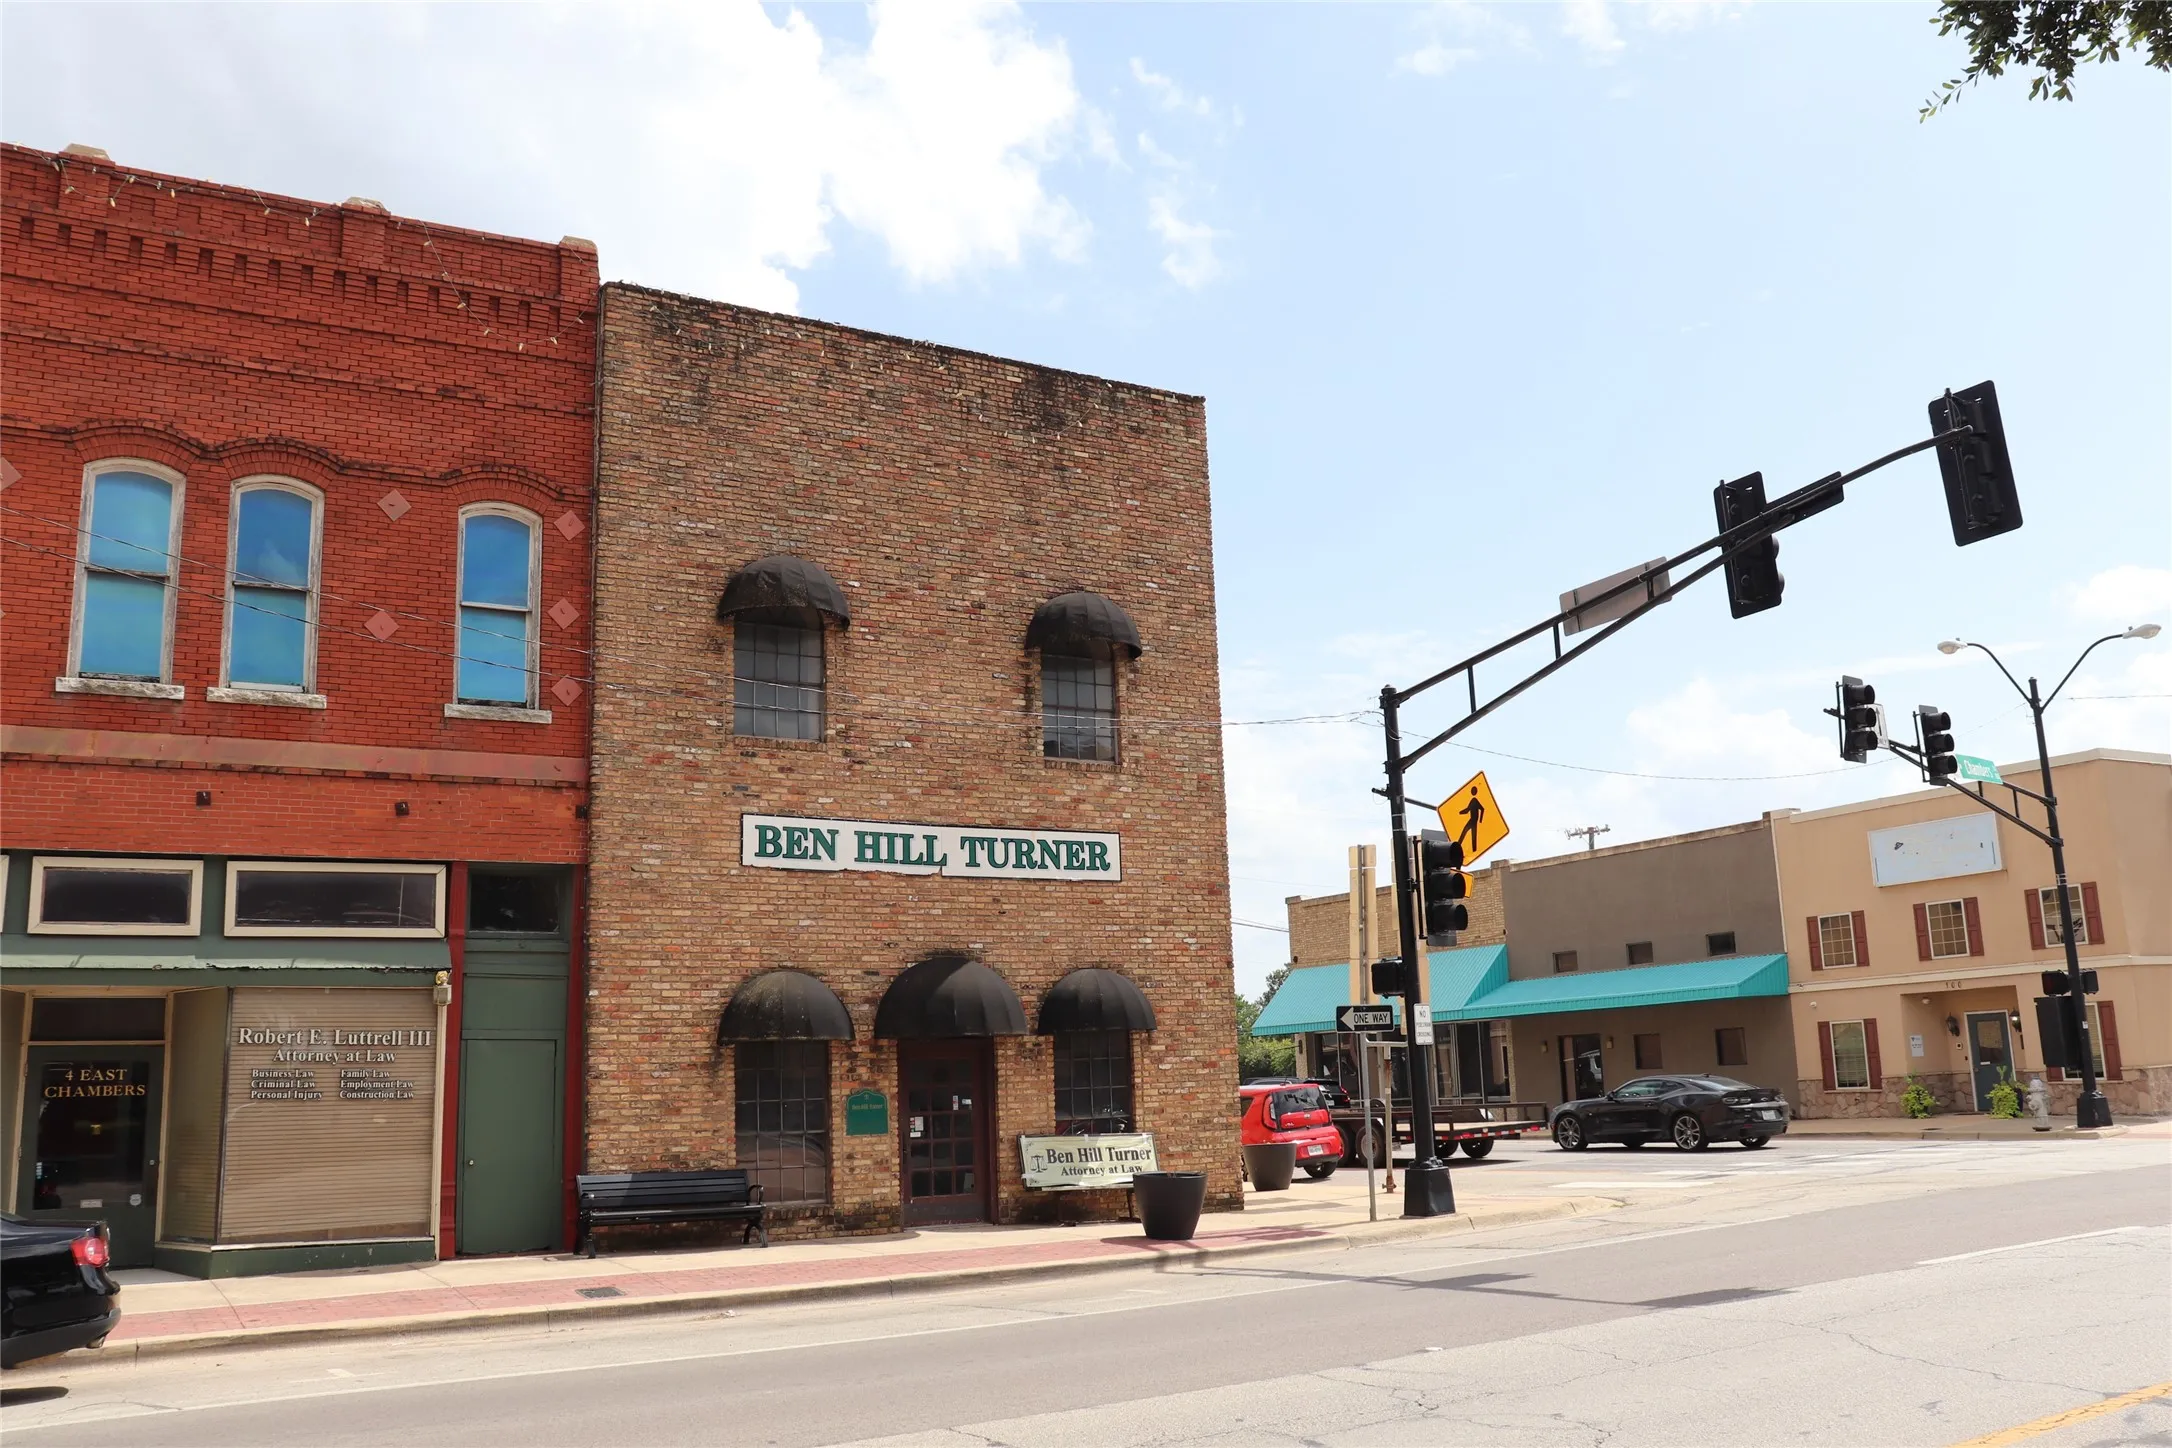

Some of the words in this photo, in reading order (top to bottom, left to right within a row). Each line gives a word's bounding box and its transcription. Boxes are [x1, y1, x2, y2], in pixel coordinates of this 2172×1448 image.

[754, 824, 839, 861] BEN
[854, 830, 947, 867] HILL
[960, 836, 1111, 872] TURNER
[1353, 1013, 1369, 1024] ONE
[1372, 1012, 1388, 1023] WAY
[238, 1028, 303, 1045] Robert
[309, 1029, 327, 1045] E.
[334, 1029, 402, 1046] Luttrell
[408, 1030, 431, 1046] III
[272, 1049, 341, 1065] Attorney
[346, 1050, 360, 1062] at
[366, 1050, 397, 1062] Law
[65, 1070, 74, 1081] 4
[80, 1069, 127, 1081] EAST
[252, 1070, 292, 1078] Business
[295, 1070, 315, 1078] Law
[340, 1070, 370, 1079] Family
[372, 1070, 390, 1078] Law
[251, 1080, 294, 1088] Criminal
[297, 1080, 316, 1088] Law
[340, 1080, 394, 1090] Employment
[396, 1080, 413, 1088] Law
[44, 1085, 146, 1098] CHAMBERS
[251, 1091, 291, 1099] Personal
[294, 1091, 323, 1100] Injury
[339, 1091, 394, 1099] Construction
[397, 1091, 414, 1099] Law
[1046, 1149, 1074, 1164] Ben
[1077, 1147, 1103, 1162] Hill
[1105, 1147, 1152, 1161] Turner
[1060, 1165, 1106, 1176] Attorney
[1108, 1166, 1118, 1174] at
[1121, 1164, 1143, 1173] Law
